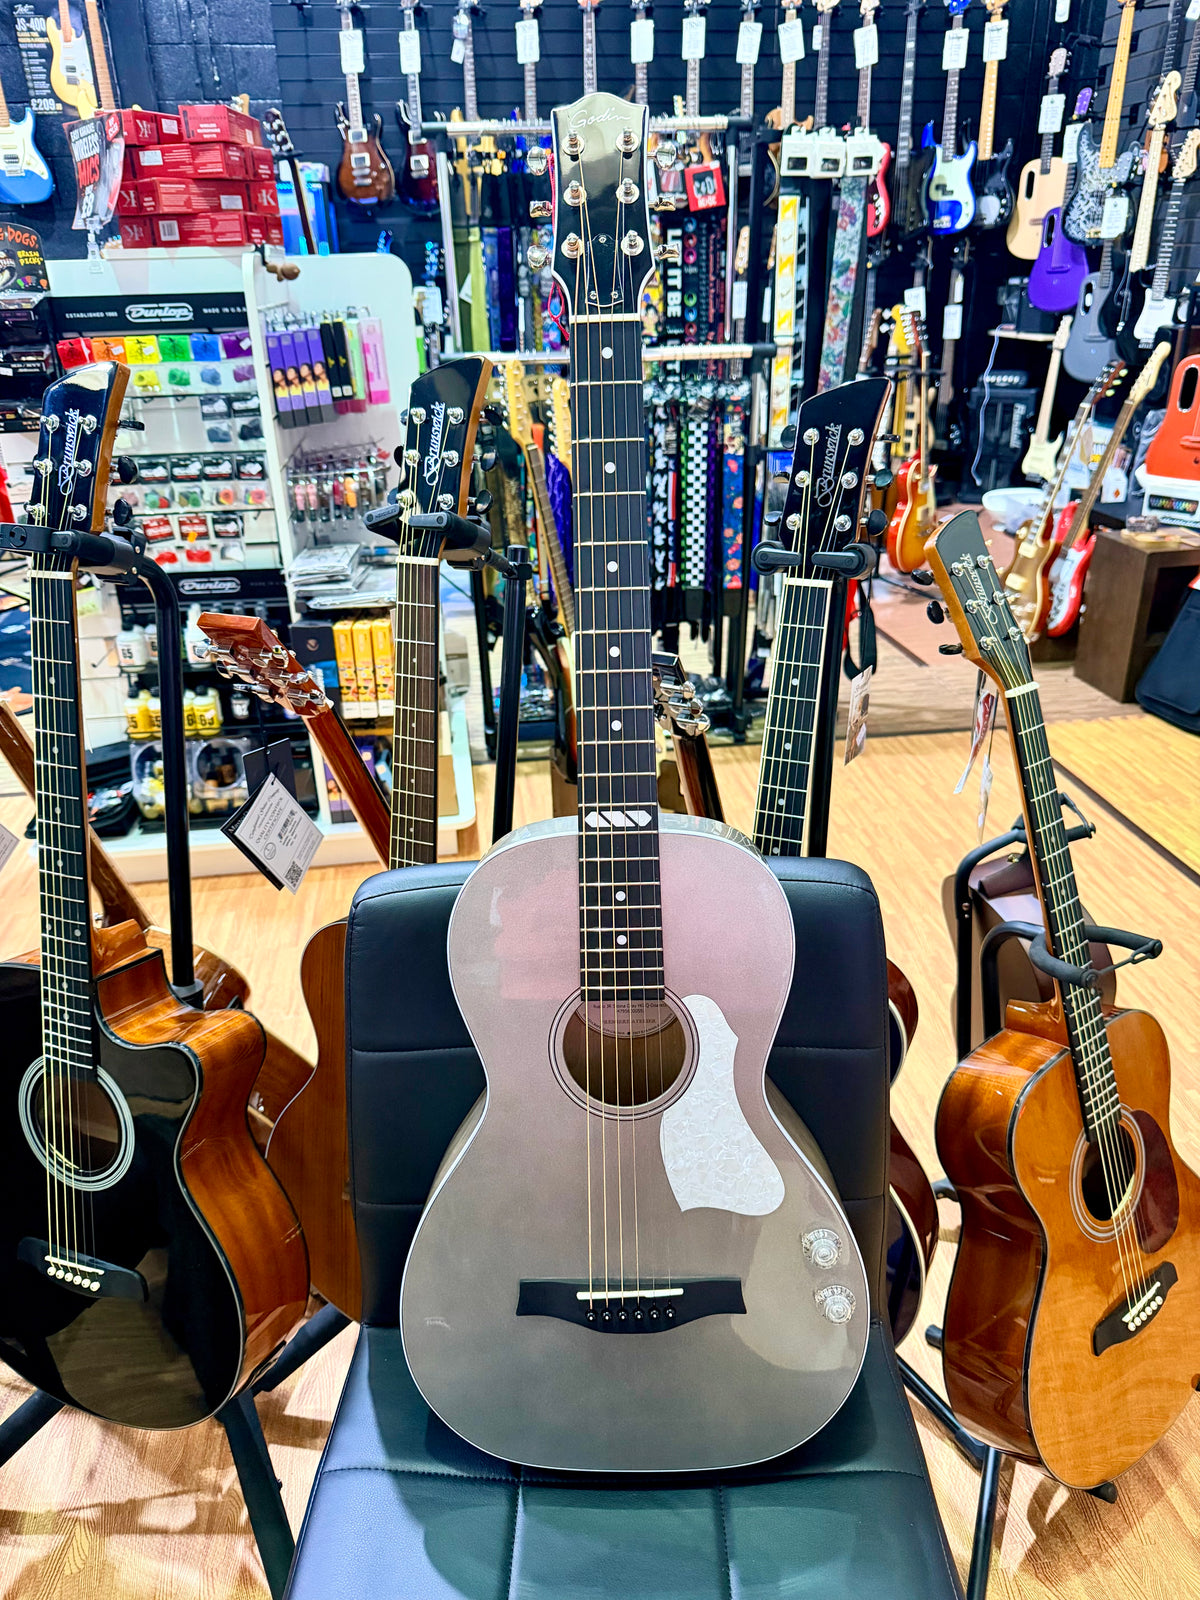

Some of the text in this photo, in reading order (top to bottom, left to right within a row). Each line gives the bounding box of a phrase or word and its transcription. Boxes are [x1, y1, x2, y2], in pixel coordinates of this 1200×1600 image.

[16, 17, 46, 32] JS-400
[570, 107, 632, 128] Godin
[77, 153, 100, 188] MICS
[129, 305, 191, 320] Dunlop
[667, 291, 682, 318] BE
[57, 407, 80, 496] Brunswick
[423, 401, 446, 486] Brunswick
[813, 422, 842, 507] Brunswick
[182, 580, 239, 592] Dunlop
